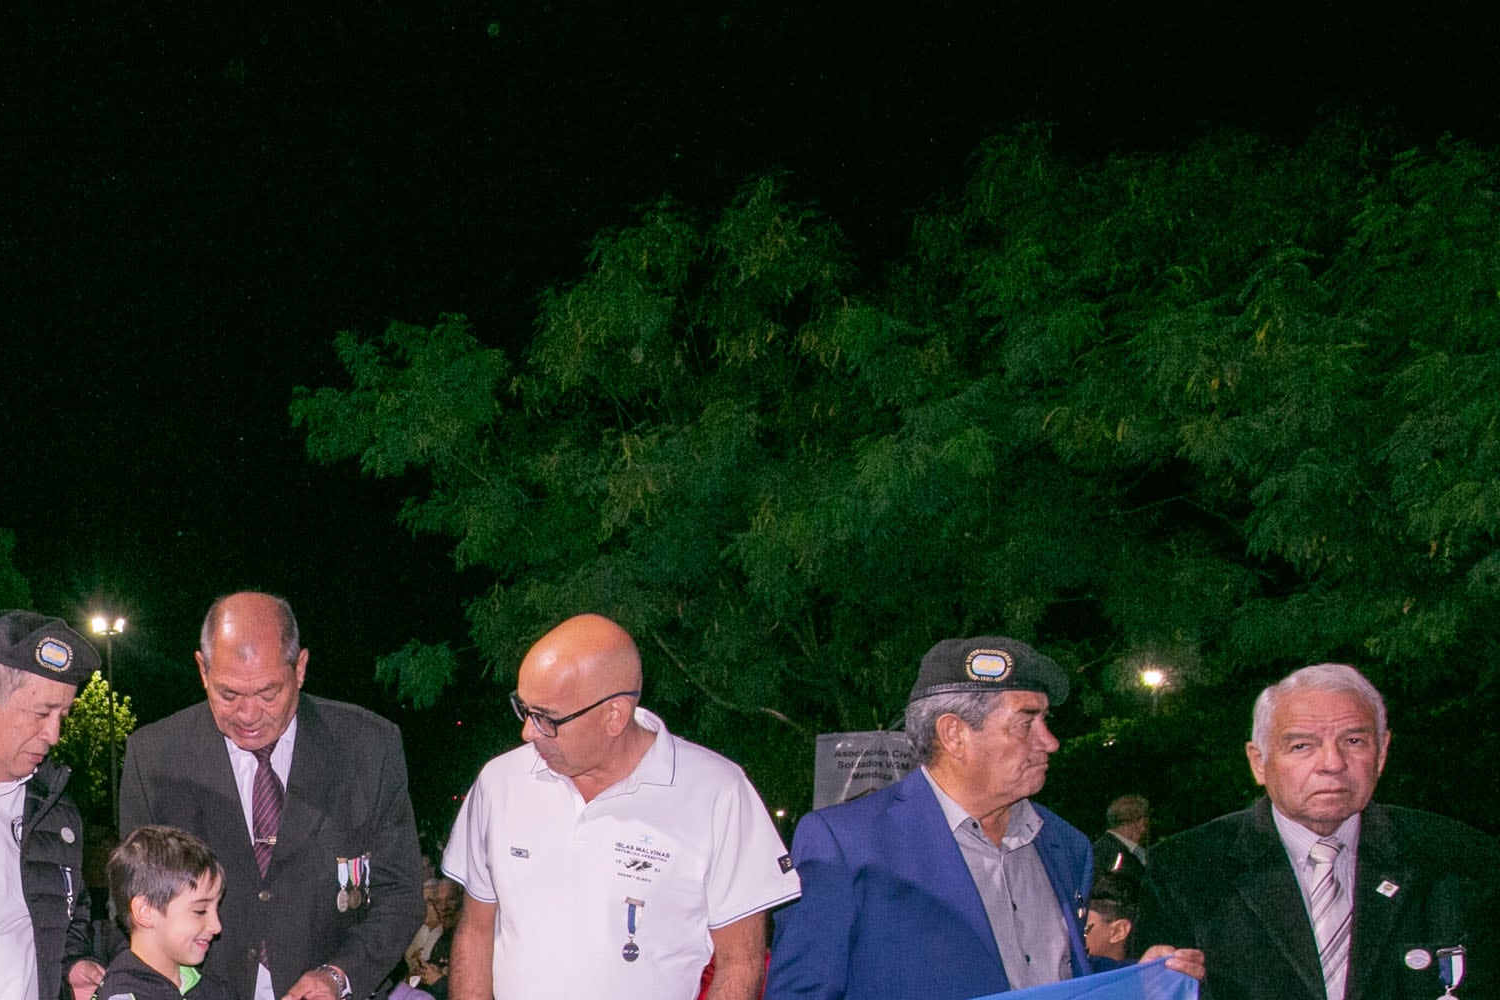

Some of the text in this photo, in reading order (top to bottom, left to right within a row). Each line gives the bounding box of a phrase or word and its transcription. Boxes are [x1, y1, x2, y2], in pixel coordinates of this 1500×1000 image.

[834, 747, 913, 759] Asociación Civi
[837, 760, 911, 771] Soldados VGM
[852, 773, 893, 782] Mendoza
[615, 842, 671, 859] ISLAS MALVINAS
